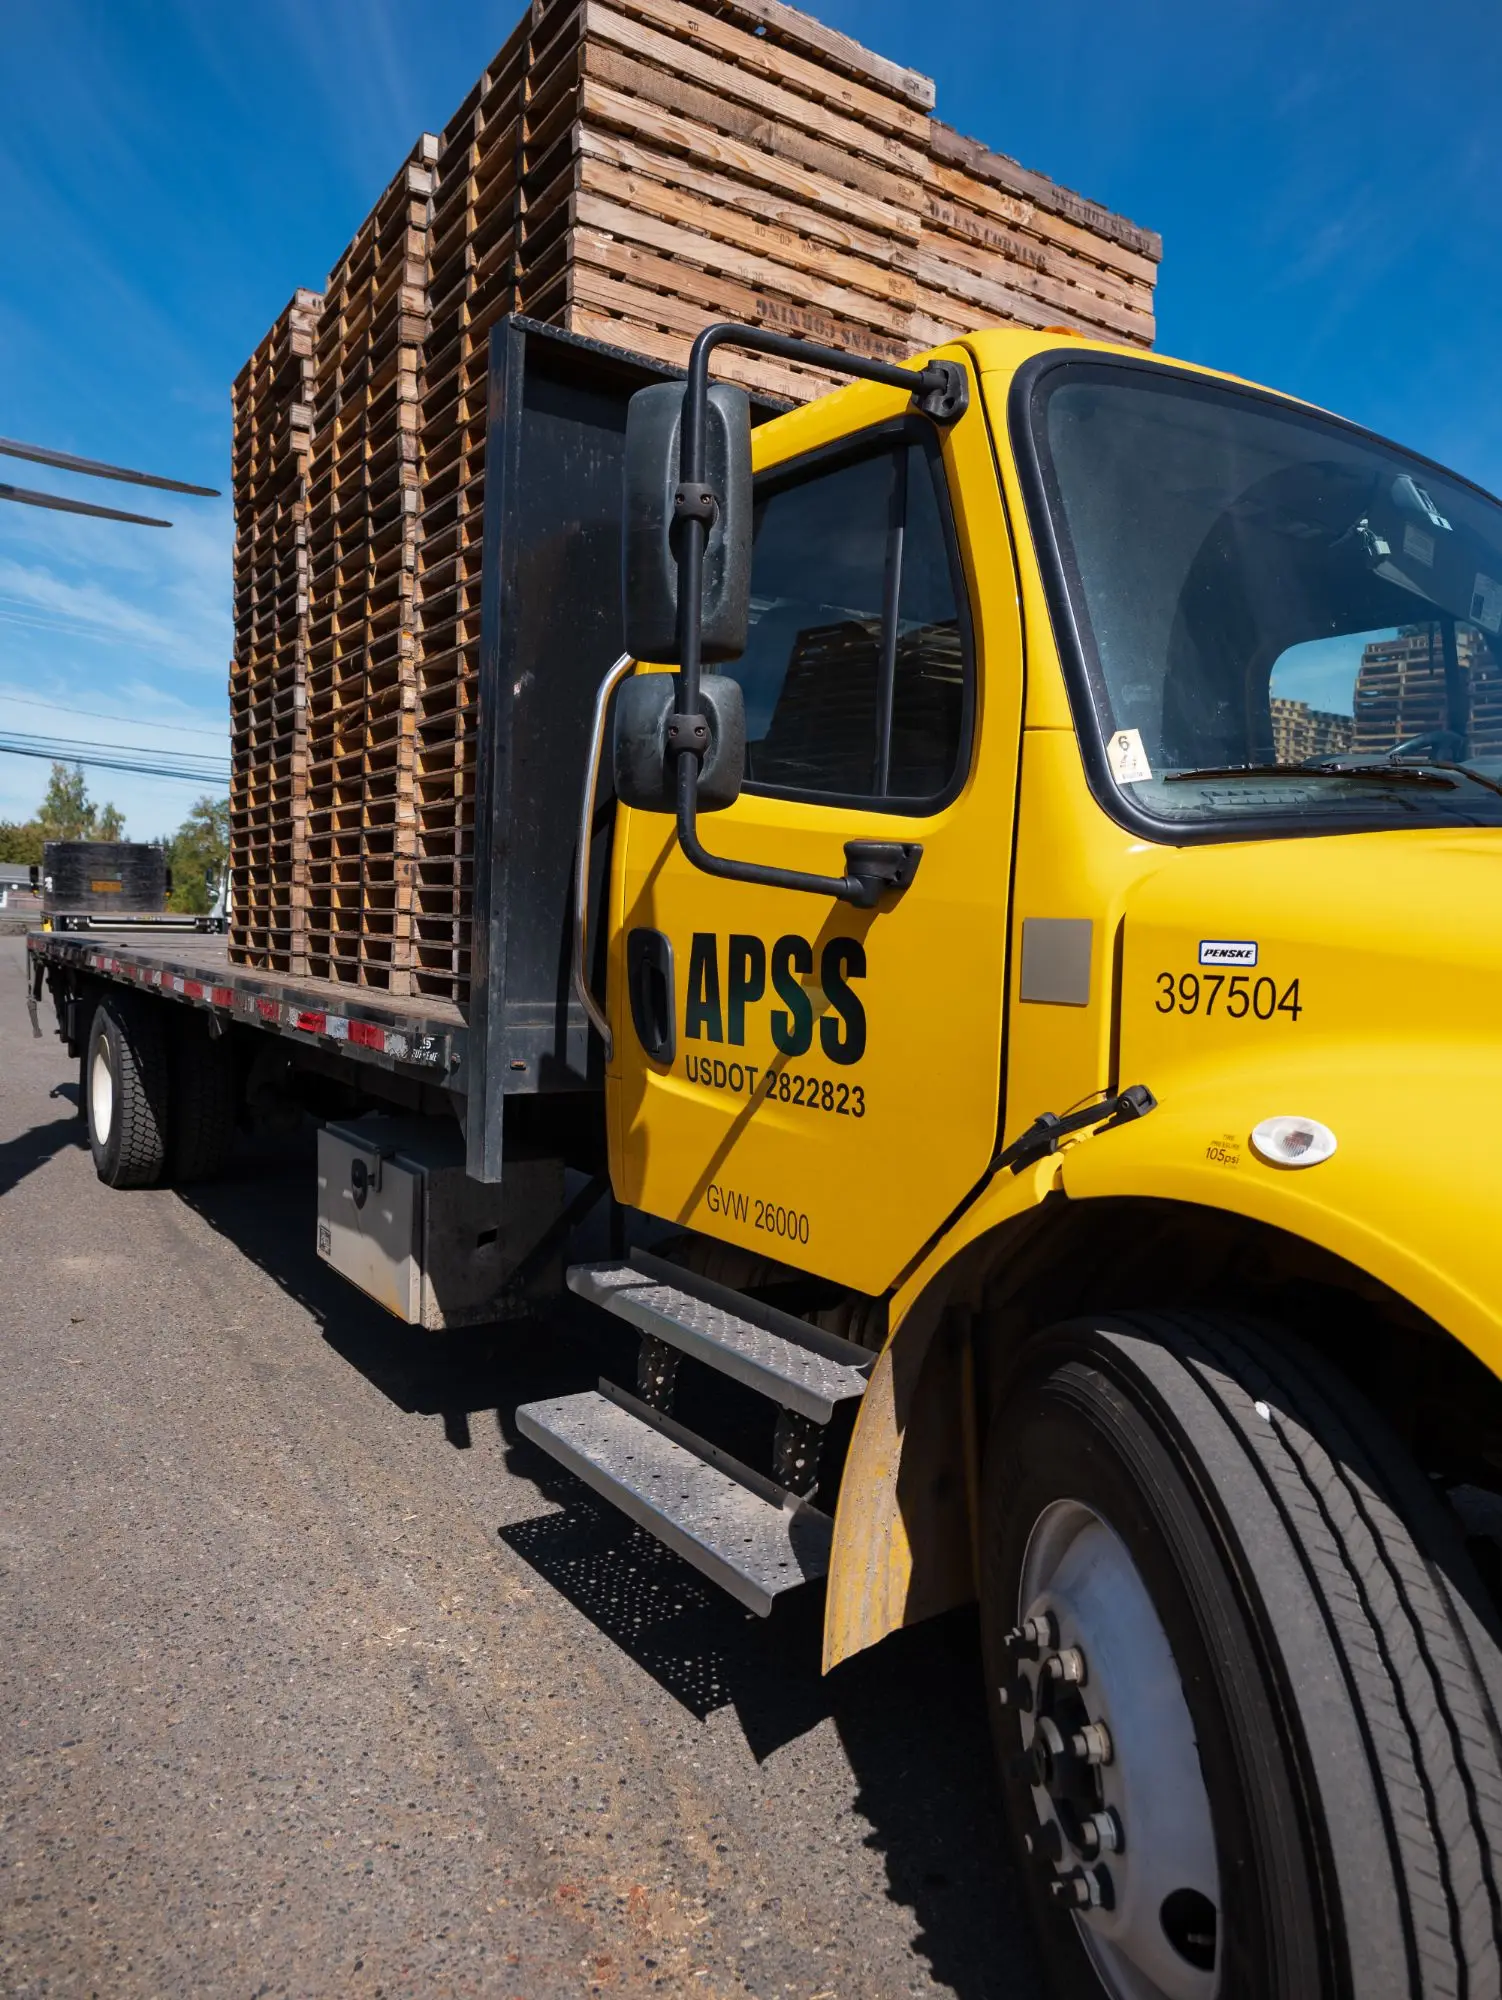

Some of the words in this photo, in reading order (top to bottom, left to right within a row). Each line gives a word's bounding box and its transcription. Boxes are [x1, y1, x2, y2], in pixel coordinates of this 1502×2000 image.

[756, 299, 836, 339] CORNING
[1203, 948, 1254, 958] PENSKE
[685, 932, 867, 1066] APSS
[1155, 972, 1303, 1021] 397504
[685, 1055, 758, 1095] USDOT
[765, 1070, 866, 1118] 2822823
[1206, 1147, 1240, 1166] 105psi
[707, 1184, 749, 1223] GVW
[754, 1200, 810, 1244] 26000
